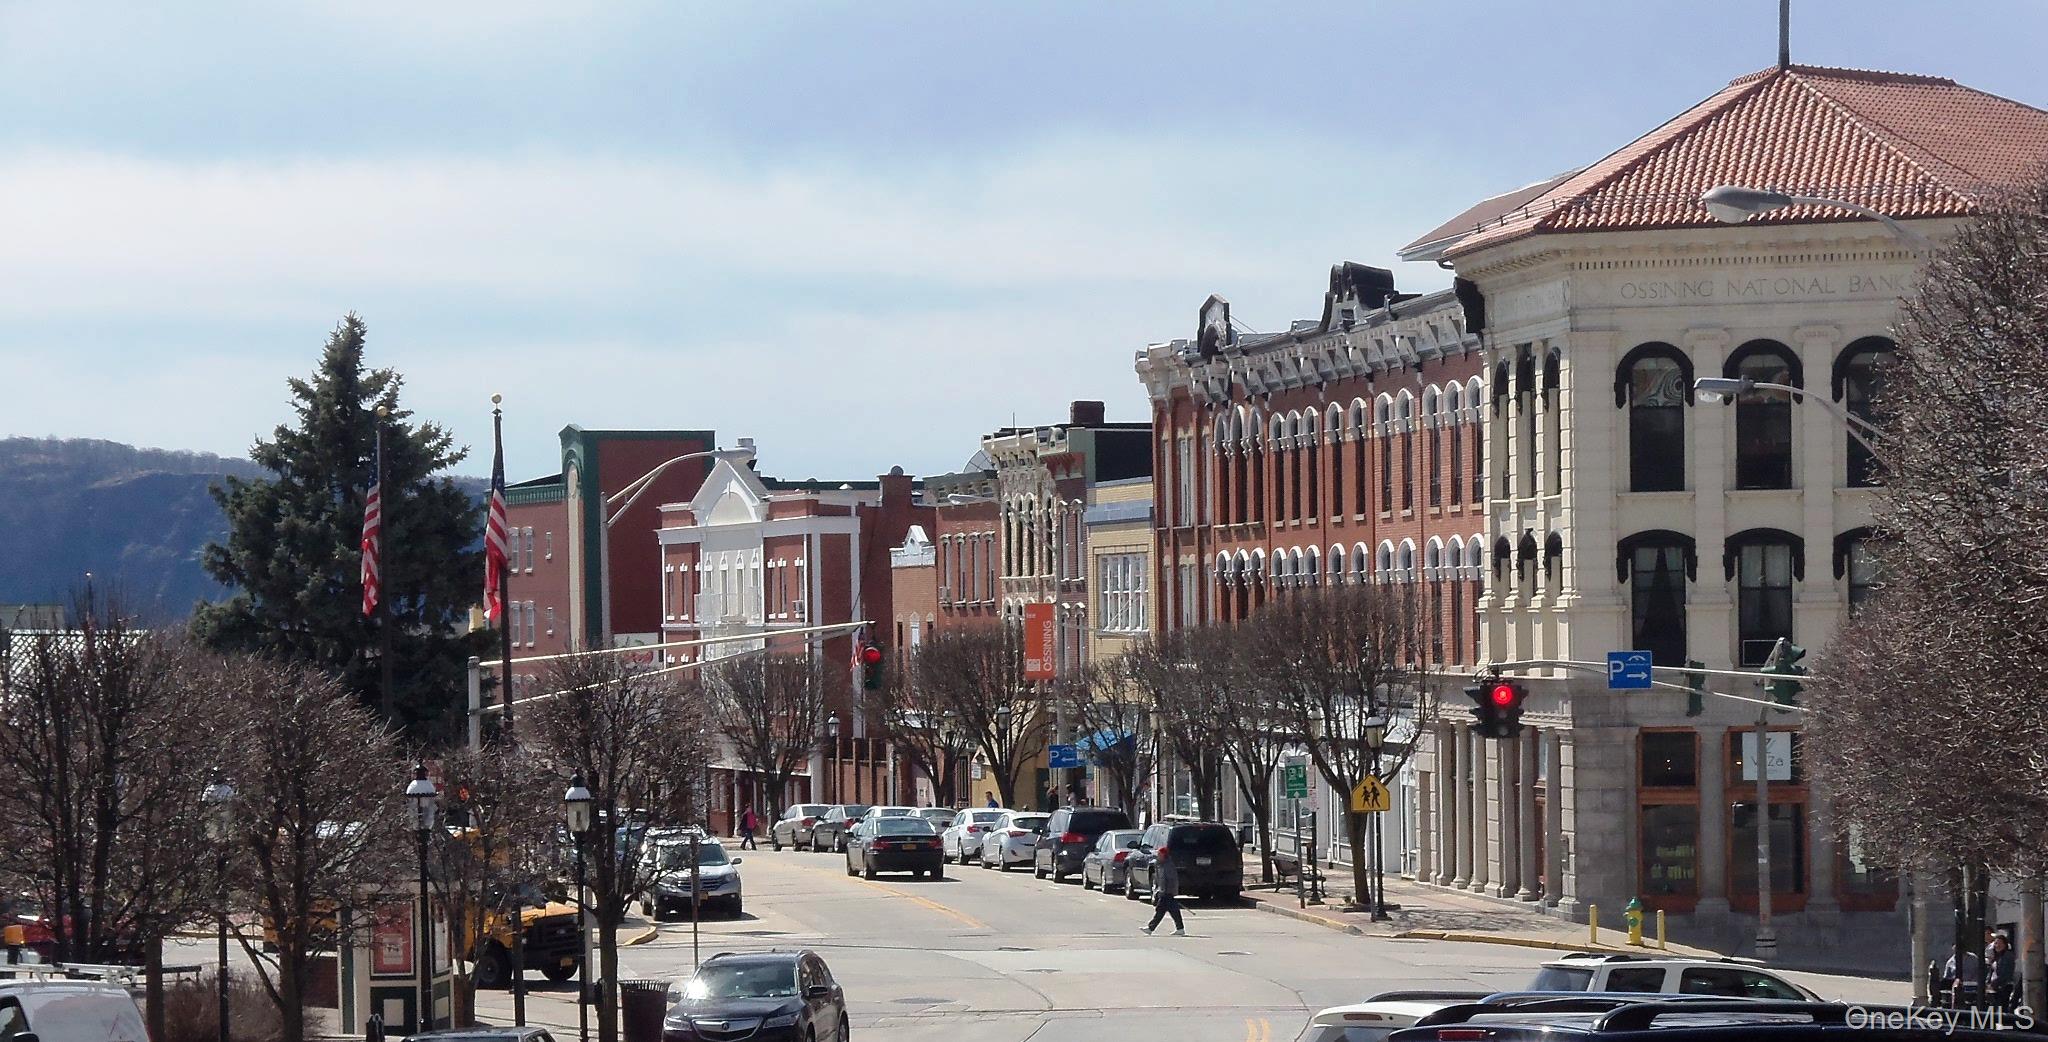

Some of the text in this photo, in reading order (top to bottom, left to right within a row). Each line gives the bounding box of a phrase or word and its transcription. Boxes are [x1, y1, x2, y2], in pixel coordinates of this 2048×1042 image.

[1620, 274, 1907, 299] OSSINING NATONAL BANK
[1043, 620, 1053, 672] OSSINING
[1610, 660, 1624, 681] P
[1050, 750, 1059, 764] P
